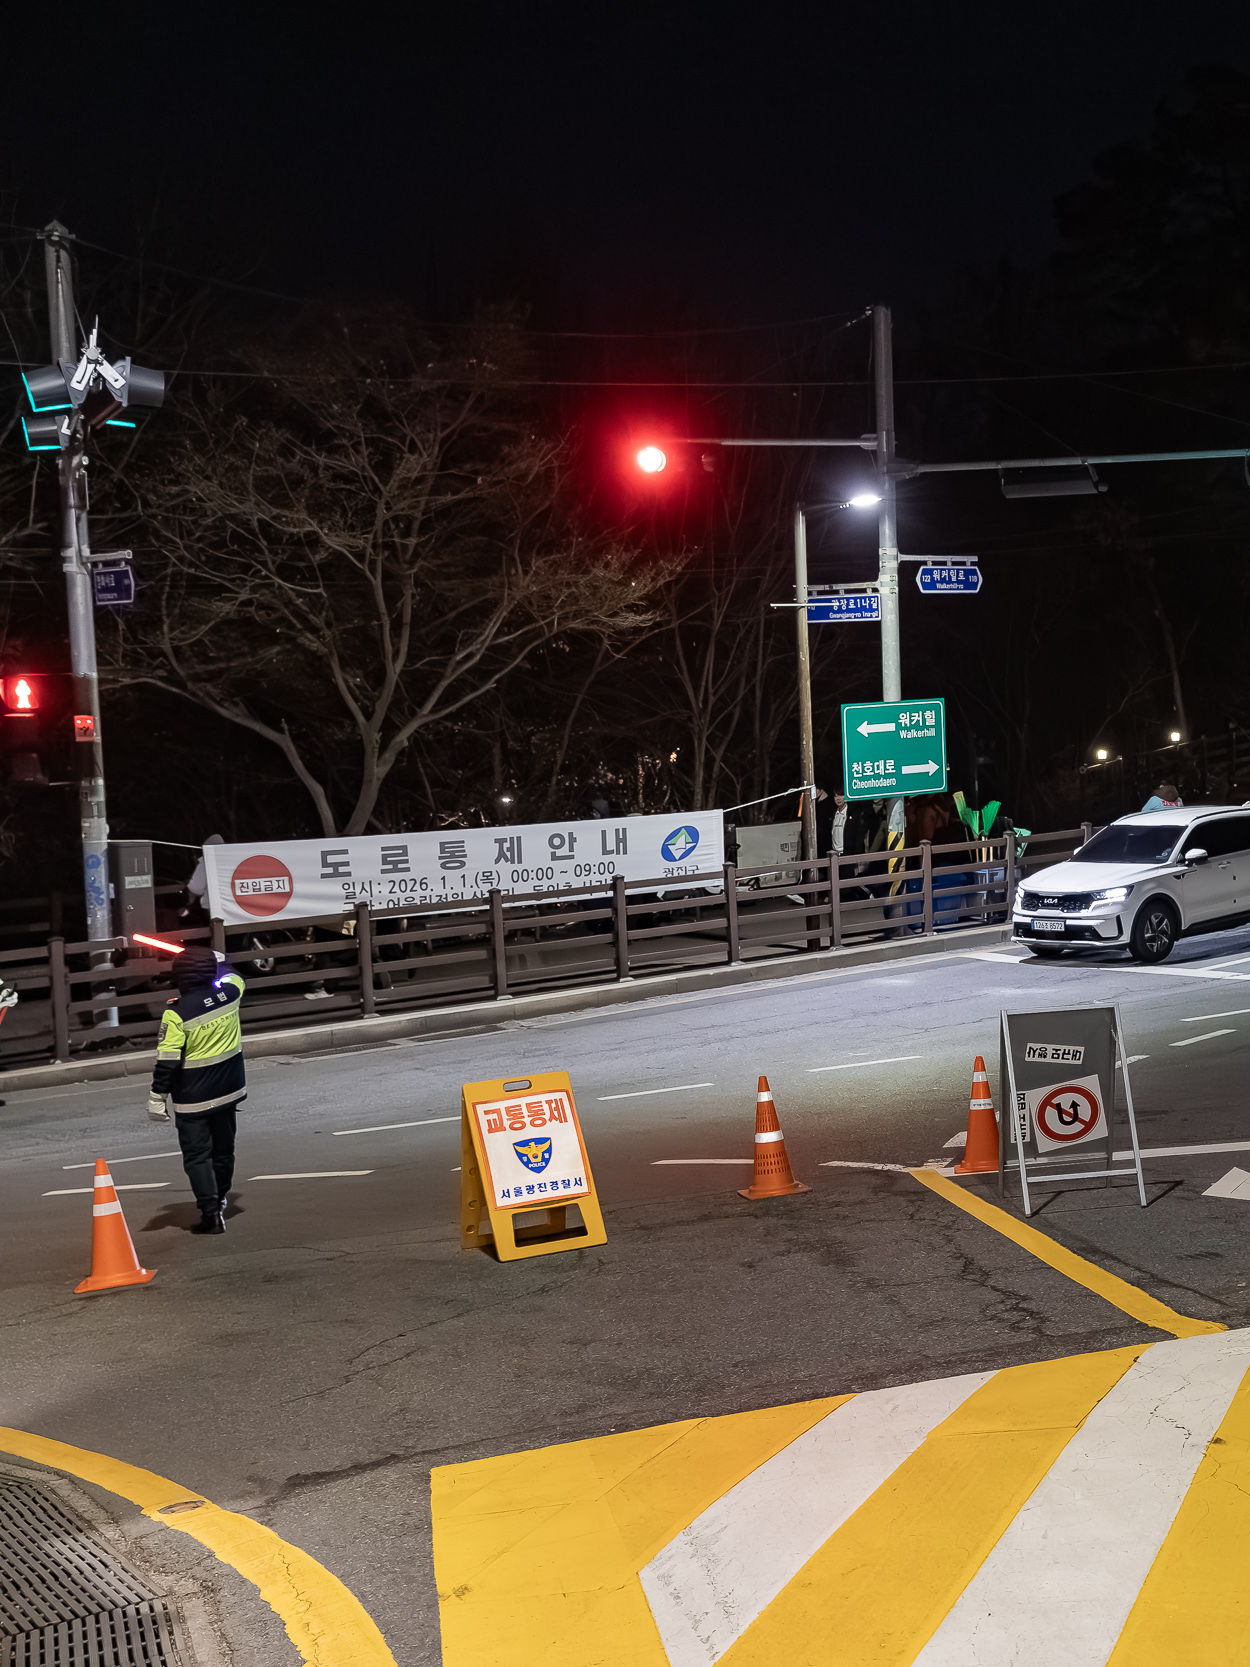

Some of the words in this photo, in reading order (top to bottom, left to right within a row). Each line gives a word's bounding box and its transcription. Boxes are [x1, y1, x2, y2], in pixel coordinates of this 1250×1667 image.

[932, 569, 966, 582] 워커힐로
[898, 710, 936, 728] 워커힐
[899, 728, 936, 739] Walkerhill
[851, 759, 896, 778] 천호대로
[852, 777, 897, 790] Cheonhodaero
[388, 877, 434, 895] 2026.
[511, 866, 554, 884] 00:00
[574, 861, 616, 878] 09:00
[239, 879, 286, 893] 진입금지
[1027, 1046, 1048, 1059] 행사
[1051, 1048, 1082, 1061] 대규모
[483, 1098, 569, 1134] 교통통제
[500, 1176, 583, 1199] 서울광진경찰서
